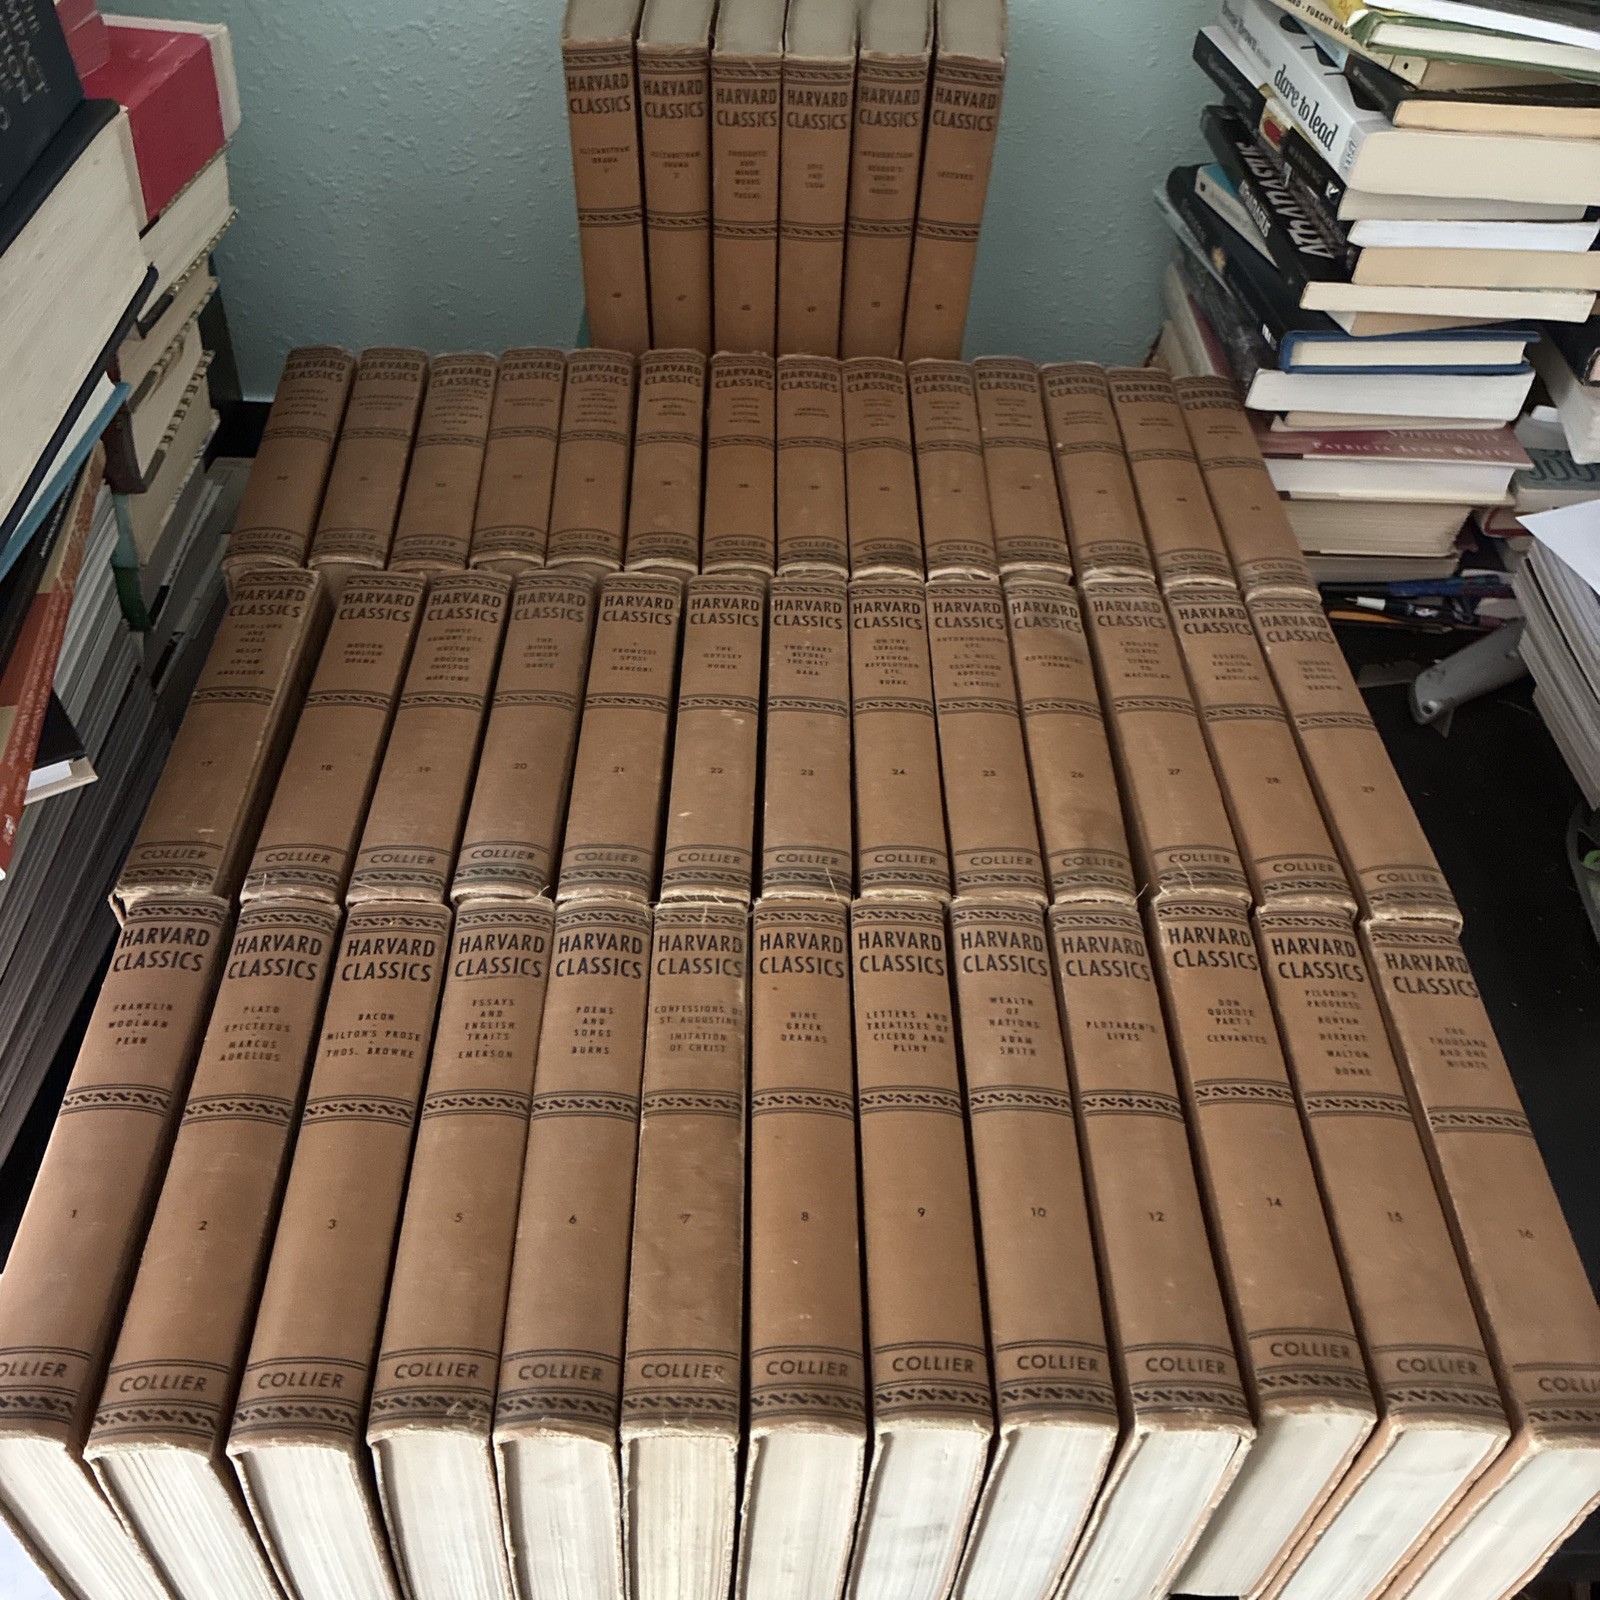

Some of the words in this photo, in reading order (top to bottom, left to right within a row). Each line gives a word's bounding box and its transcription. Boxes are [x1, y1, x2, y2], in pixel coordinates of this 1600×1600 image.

[567, 73, 629, 92] HARVARD
[643, 78, 704, 97] HARVARD
[716, 87, 778, 106] HARVARD
[787, 89, 848, 108] HARVARD
[860, 87, 921, 106] HARVARD
[935, 87, 996, 109] HARVARD
[569, 94, 631, 115] CLASSICS
[644, 101, 705, 120] CLASSICS
[1274, 64, 1299, 106] dare
[1297, 97, 1311, 117] to
[1309, 100, 1338, 151] lead
[716, 109, 778, 128] CLASSICS
[787, 110, 848, 130] CLASSICS
[859, 108, 919, 128] CLASSICS
[932, 110, 993, 131] CLASSICS
[236, 588, 306, 602] HARVARD
[343, 593, 415, 607] HARVARD
[431, 591, 501, 608] HARVARD
[517, 592, 586, 608] HARVARD
[604, 595, 674, 610] HARVARD
[691, 598, 760, 612] HARVARD
[774, 600, 842, 614] HARVARD
[853, 601, 921, 615] HARVARD
[933, 601, 1001, 615] HARVARD
[1094, 599, 1161, 614] HARVARD
[229, 604, 301, 618] CLASSICS
[338, 609, 412, 623] CLASSICS
[427, 608, 499, 624] CLASSICS
[514, 607, 585, 623] CLASSICS
[1011, 602, 1079, 619] HARVARD
[1179, 607, 1248, 620] HARVARD
[602, 611, 673, 626] CLASSICS
[690, 611, 760, 627] CLASSICS
[773, 614, 843, 630] CLASSICS
[854, 616, 923, 630] CLASSICS
[935, 616, 1005, 630] CLASSICS
[1014, 617, 1083, 633] CLASSICS
[1097, 615, 1167, 630] CLASSICS
[1261, 615, 1327, 629] HARVARD
[1184, 621, 1253, 636] CLASSICS
[1266, 630, 1335, 644] CLASSICS
[120, 927, 211, 948] HARVARD
[458, 933, 545, 955] HARVARD
[558, 932, 643, 955] HARVARD
[658, 934, 743, 954] HARVARD
[760, 932, 844, 954] HARVARD
[858, 931, 942, 951] HARVARD
[961, 931, 1044, 951] HARVARD
[1168, 927, 1251, 948] HARVARD
[234, 935, 323, 956] HARVARD
[346, 938, 436, 957] HARVARD
[1062, 937, 1145, 957] HARVARD
[1271, 937, 1358, 958] HARVARD
[113, 951, 204, 972] CLASSICS
[454, 956, 542, 978] CLASSICS
[759, 956, 845, 978] CLASSICS
[859, 955, 945, 977] CLASSICS
[963, 954, 1048, 977] CLASSICS
[1173, 948, 1259, 972] CLASSICS
[1384, 953, 1470, 974] HARVARD
[227, 958, 318, 981] CLASSICS
[341, 962, 432, 983] CLASSICS
[555, 956, 643, 979] CLASSICS
[657, 957, 743, 978] CLASSICS
[1065, 959, 1150, 982] CLASSICS
[1278, 962, 1365, 983] CLASSICS
[1393, 976, 1479, 998] CLASSICS
[113, 1003, 173, 1012] FRANKLIN
[472, 999, 515, 1007] ESSAYS
[989, 996, 1034, 1006] WEALTH
[1218, 999, 1240, 1007] DON
[243, 1006, 280, 1014] PLATO
[480, 1010, 503, 1018] AND
[576, 1006, 614, 1015] POEMS
[654, 1005, 725, 1014] CONFESSIONS
[790, 1011, 818, 1020] NINE
[867, 1010, 916, 1020] LETTERS
[926, 1012, 948, 1022] AND
[1006, 1008, 1019, 1016] OF
[1207, 1008, 1255, 1018] QUIXOTE
[358, 1013, 395, 1021] BACON
[680, 1016, 738, 1026] AUGUSTINE
[989, 1019, 1041, 1029] NATIONS
[109, 1020, 168, 1029] WOOLMAN
[224, 1023, 292, 1033] EPICTETUS
[465, 1022, 515, 1030] ENGLISH
[786, 1023, 822, 1031] GREEK
[867, 1022, 929, 1031] TREATISES
[1086, 1021, 1156, 1033] PLUTARCH'S
[326, 1030, 377, 1041] MILTON'S
[385, 1030, 422, 1042] PROSE
[467, 1033, 510, 1041] TRAITS
[574, 1029, 612, 1037] SONGS
[670, 1033, 727, 1041] IMITATION
[781, 1034, 828, 1044] DRAMAS
[873, 1033, 916, 1041] CICERO
[923, 1034, 945, 1044] AND
[1106, 1033, 1140, 1041] LIVES
[1207, 1034, 1268, 1045] CERVANTES
[116, 1037, 148, 1045] PENN
[229, 1040, 278, 1049] MARCUS
[1001, 1036, 1033, 1045] ADAM
[367, 1047, 415, 1059] BROWNE
[458, 1051, 513, 1059] EMERSON
[571, 1046, 610, 1055] BURNS
[670, 1044, 682, 1052] OF
[689, 1044, 726, 1053] CHRIST
[893, 1045, 927, 1053] PLINY
[1000, 1047, 1036, 1056] SMITH
[219, 1052, 281, 1062] AURELIUS
[1267, 1196, 1282, 1208] 14
[71, 1209, 78, 1219] 1
[455, 1212, 464, 1223] 5
[569, 1214, 578, 1225] 6
[682, 1214, 691, 1224] 7
[801, 1211, 810, 1222] 8
[917, 1207, 926, 1218] 9
[1031, 1207, 1046, 1219] 10
[1149, 1211, 1164, 1223] 12
[1388, 1211, 1404, 1223] 15
[199, 1220, 208, 1231] 2
[328, 1219, 337, 1230] 3
[1517, 1227, 1534, 1240] 16
[1269, 1340, 1351, 1360] COLLIER
[766, 1360, 850, 1377] COLLIER
[892, 1356, 975, 1374] COLLIER
[1016, 1353, 1099, 1373] COLLIER
[1145, 1356, 1227, 1376] COLLIER
[1396, 1357, 1479, 1376] COLLIER
[394, 1363, 481, 1380] COLLIER
[518, 1363, 604, 1381] COLLIER
[641, 1363, 725, 1380] COLLIER
[119, 1375, 207, 1394] COLLIER
[257, 1372, 343, 1391] COLLIER
[1538, 1374, 1600, 1393] COLLI
